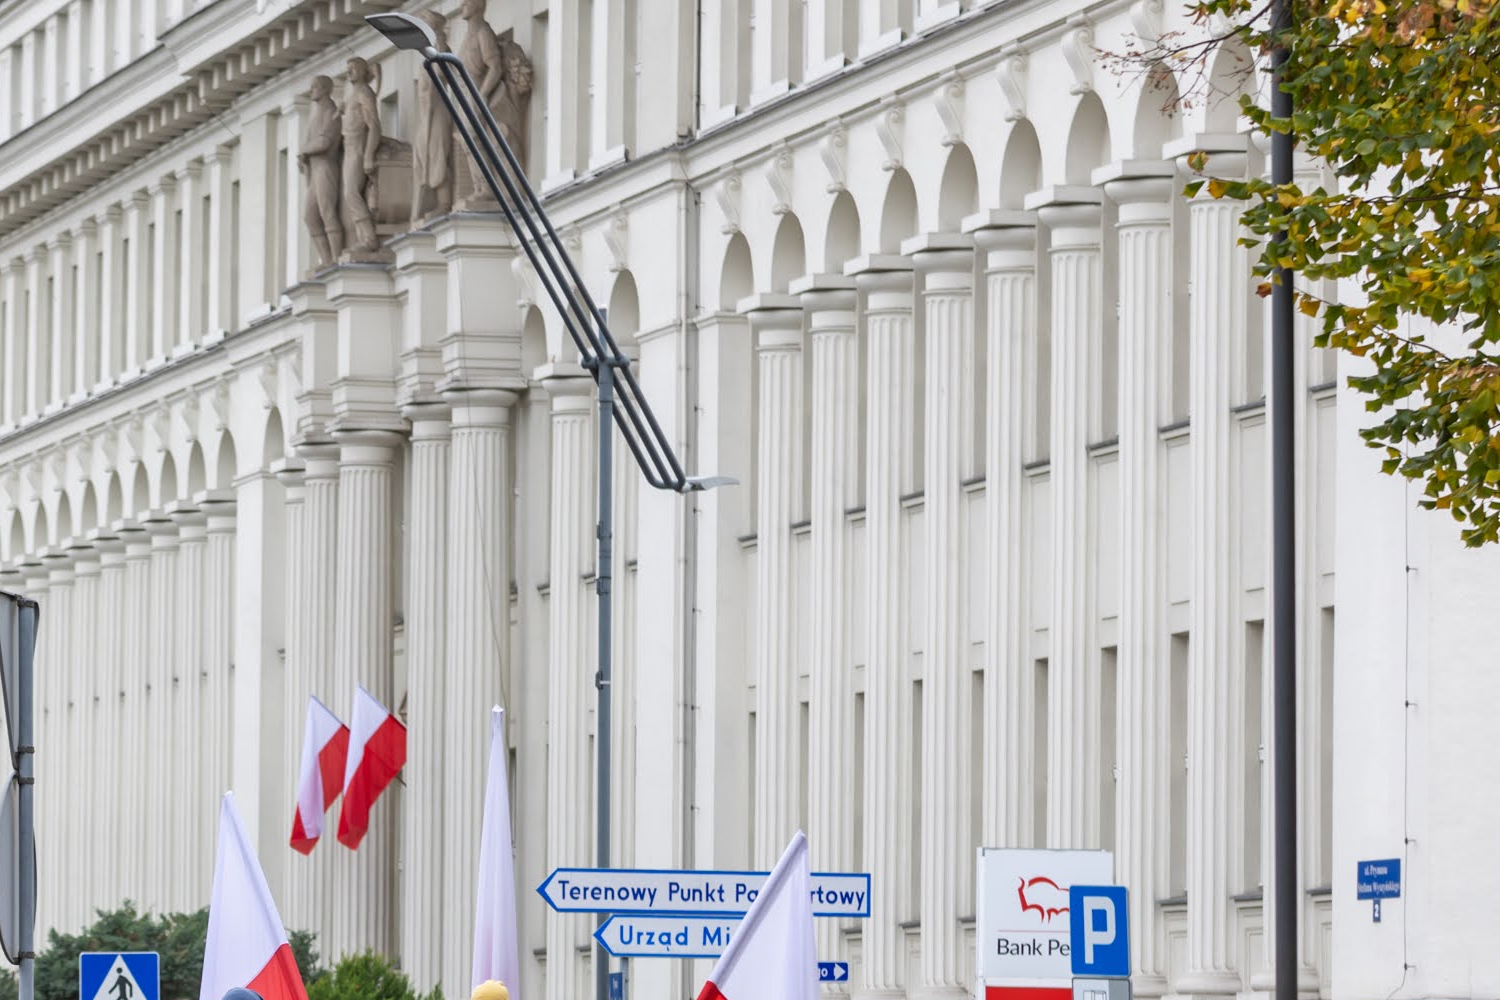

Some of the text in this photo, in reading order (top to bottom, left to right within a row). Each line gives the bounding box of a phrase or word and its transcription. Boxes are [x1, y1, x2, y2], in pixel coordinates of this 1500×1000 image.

[558, 880, 657, 907] Terenowy
[669, 882, 725, 903] Punkt
[1374, 904, 1379, 918] 2
[619, 925, 731, 951] Urząd Mi
[1083, 896, 1117, 964] P
[997, 939, 1070, 956] Bank Pe
